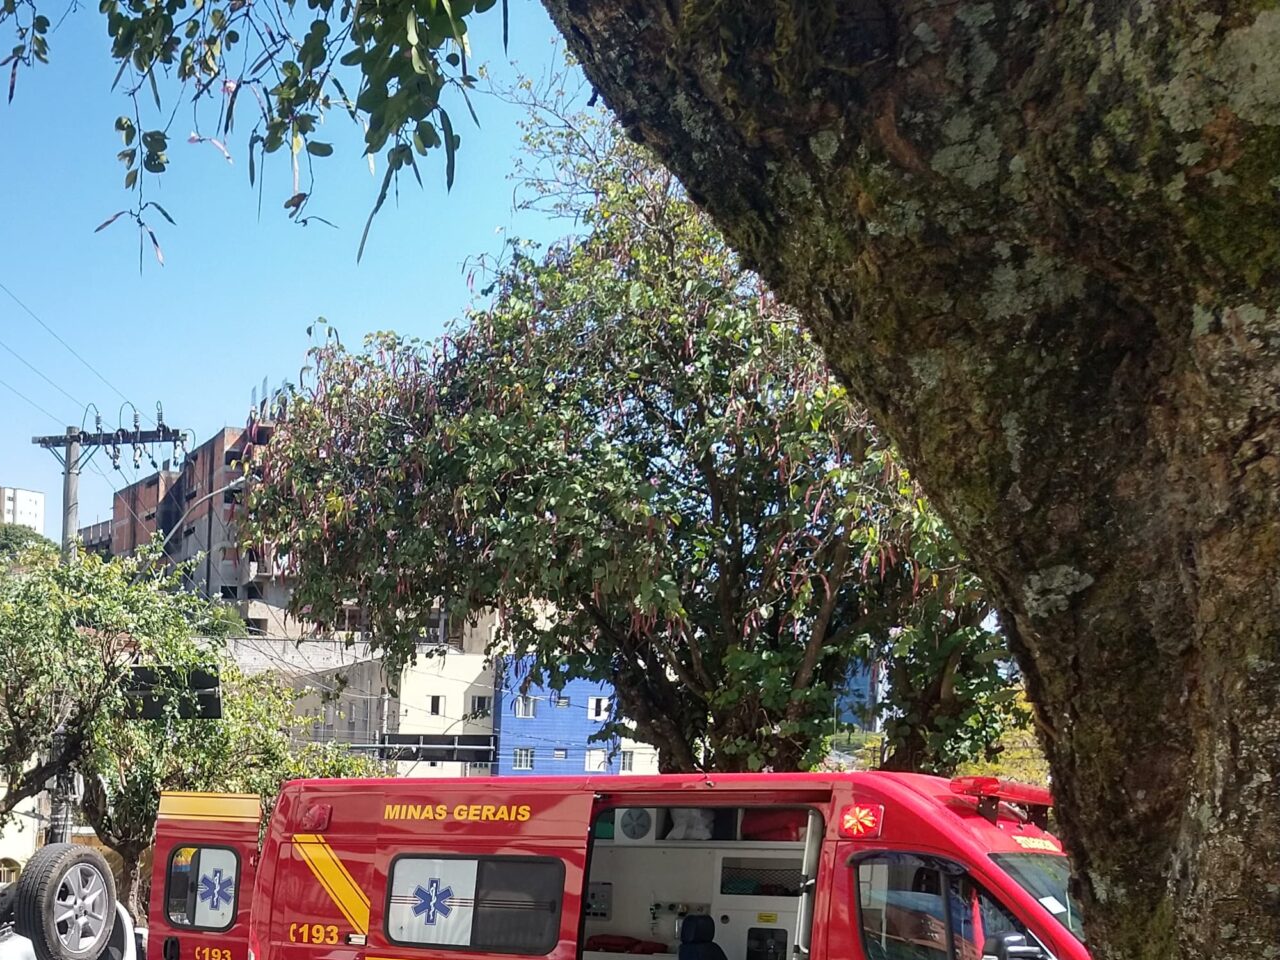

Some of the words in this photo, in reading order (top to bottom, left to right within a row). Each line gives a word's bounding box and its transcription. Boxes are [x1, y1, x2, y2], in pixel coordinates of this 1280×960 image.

[384, 804, 448, 821] MINAS
[453, 804, 532, 822] GERAIS
[298, 923, 339, 945] 193
